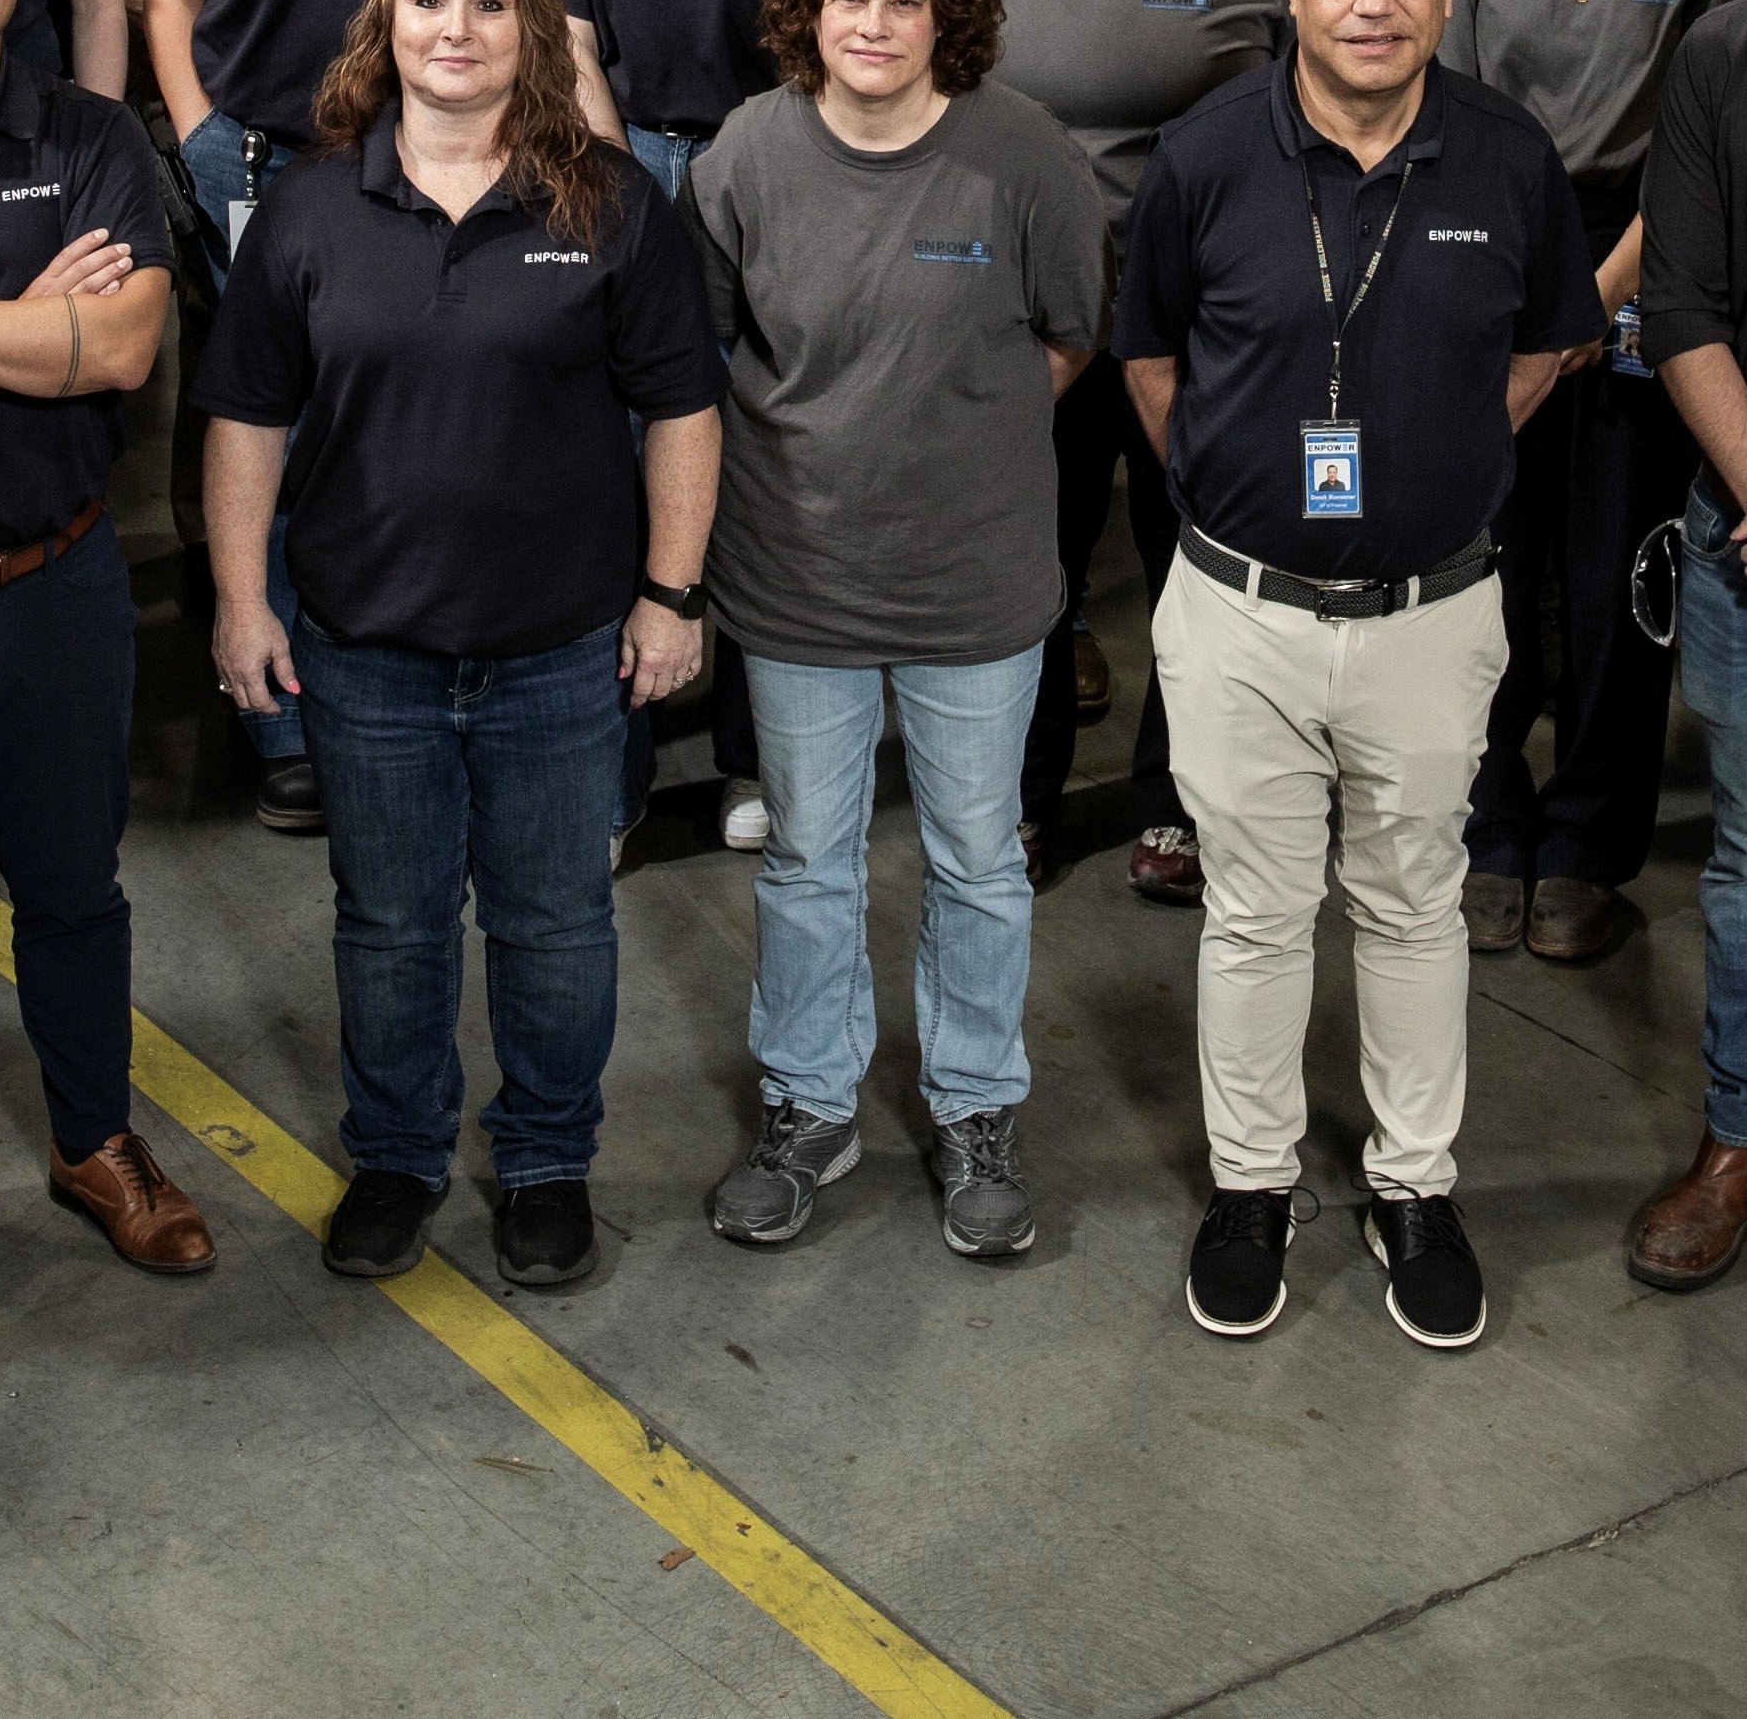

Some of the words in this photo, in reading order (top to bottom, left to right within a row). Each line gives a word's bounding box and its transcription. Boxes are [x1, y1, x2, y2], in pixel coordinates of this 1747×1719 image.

[1, 183, 61, 202] ENPOWE
[1312, 215, 1328, 269] BOILERMAKERS
[1428, 230, 1489, 243] ENPOWER
[914, 239, 992, 256] ENPOWER
[524, 251, 589, 264] ENPOWER
[1365, 251, 1381, 281] PURDUE
[1321, 273, 1333, 302] PURDUE
[1308, 444, 1355, 452] ENPOWER
